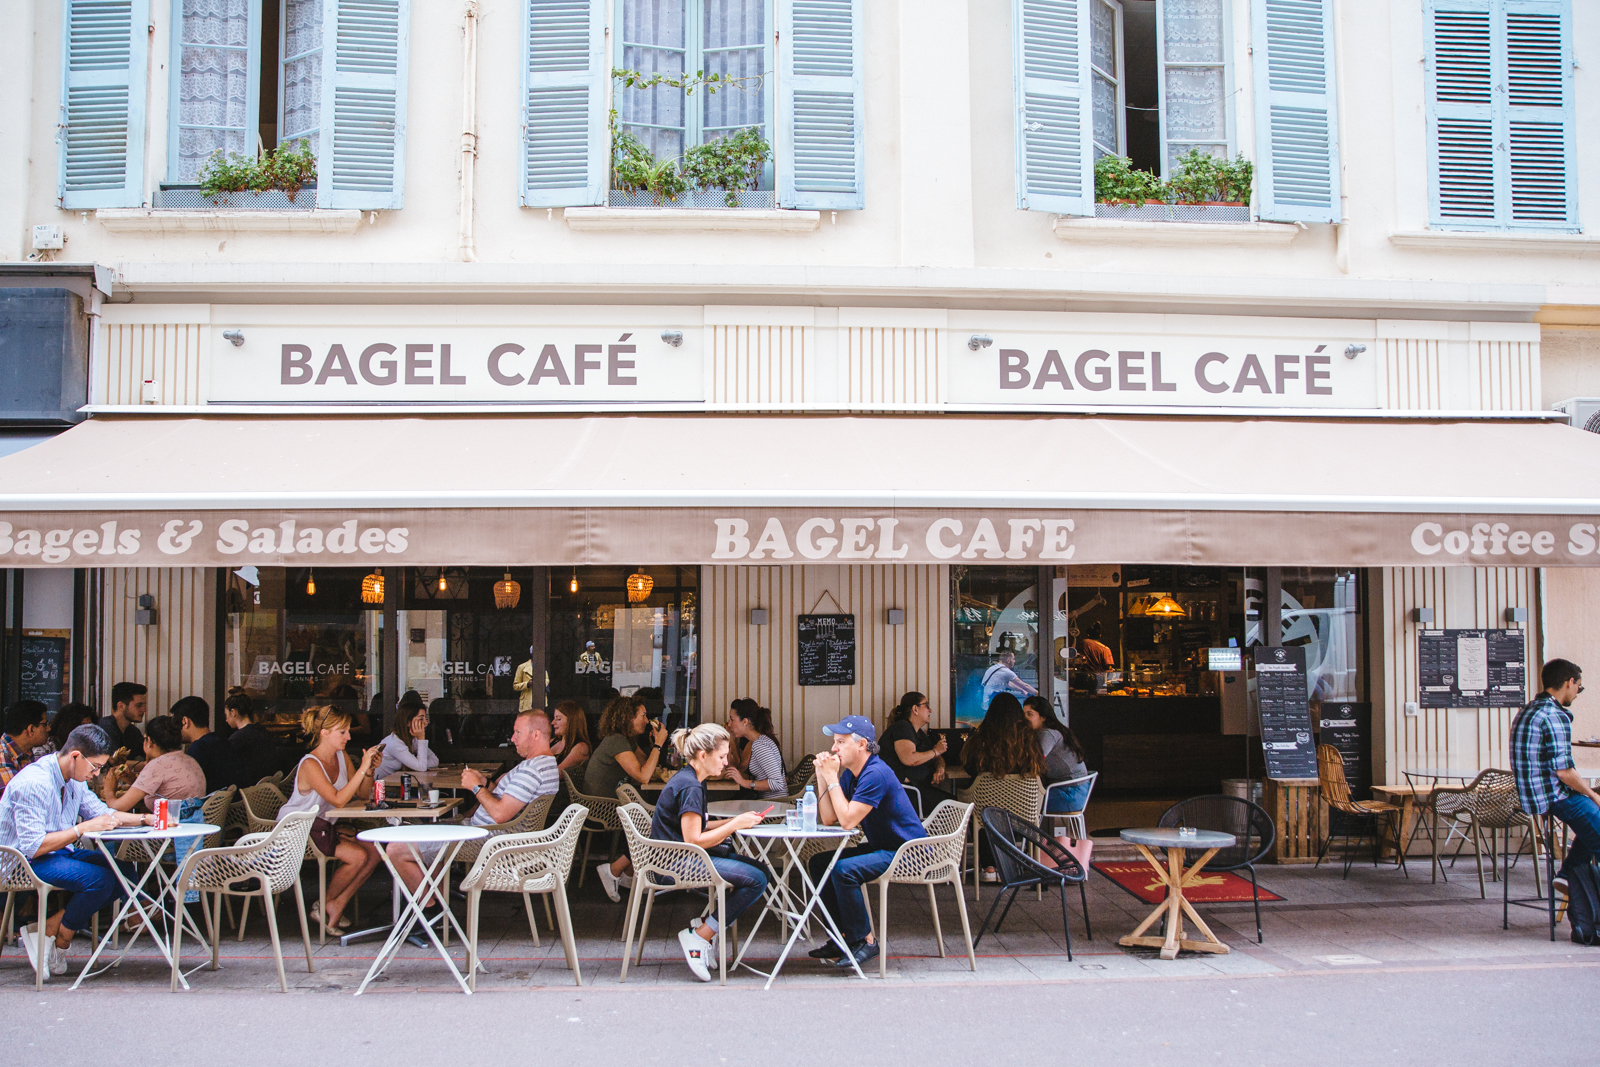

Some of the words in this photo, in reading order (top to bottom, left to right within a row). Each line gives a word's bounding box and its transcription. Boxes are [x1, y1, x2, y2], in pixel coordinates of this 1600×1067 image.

[281, 343, 466, 386] BAGEL
[487, 333, 637, 386] CAFÉ
[999, 349, 1177, 392] BAGEL
[1194, 345, 1333, 396] CAFÉ
[157, 519, 203, 554] &
[216, 519, 409, 555] Salades
[711, 517, 909, 559] BAGEL
[926, 517, 1075, 560] CAFE
[1410, 522, 1555, 555] Coffee
[1567, 523, 1600, 556] S
[258, 661, 315, 675] BAGEL
[317, 662, 350, 675] CAFÉ
[418, 661, 474, 675] BAGEL
[477, 662, 511, 675] CAÉ
[575, 661, 630, 674] BAGEL
